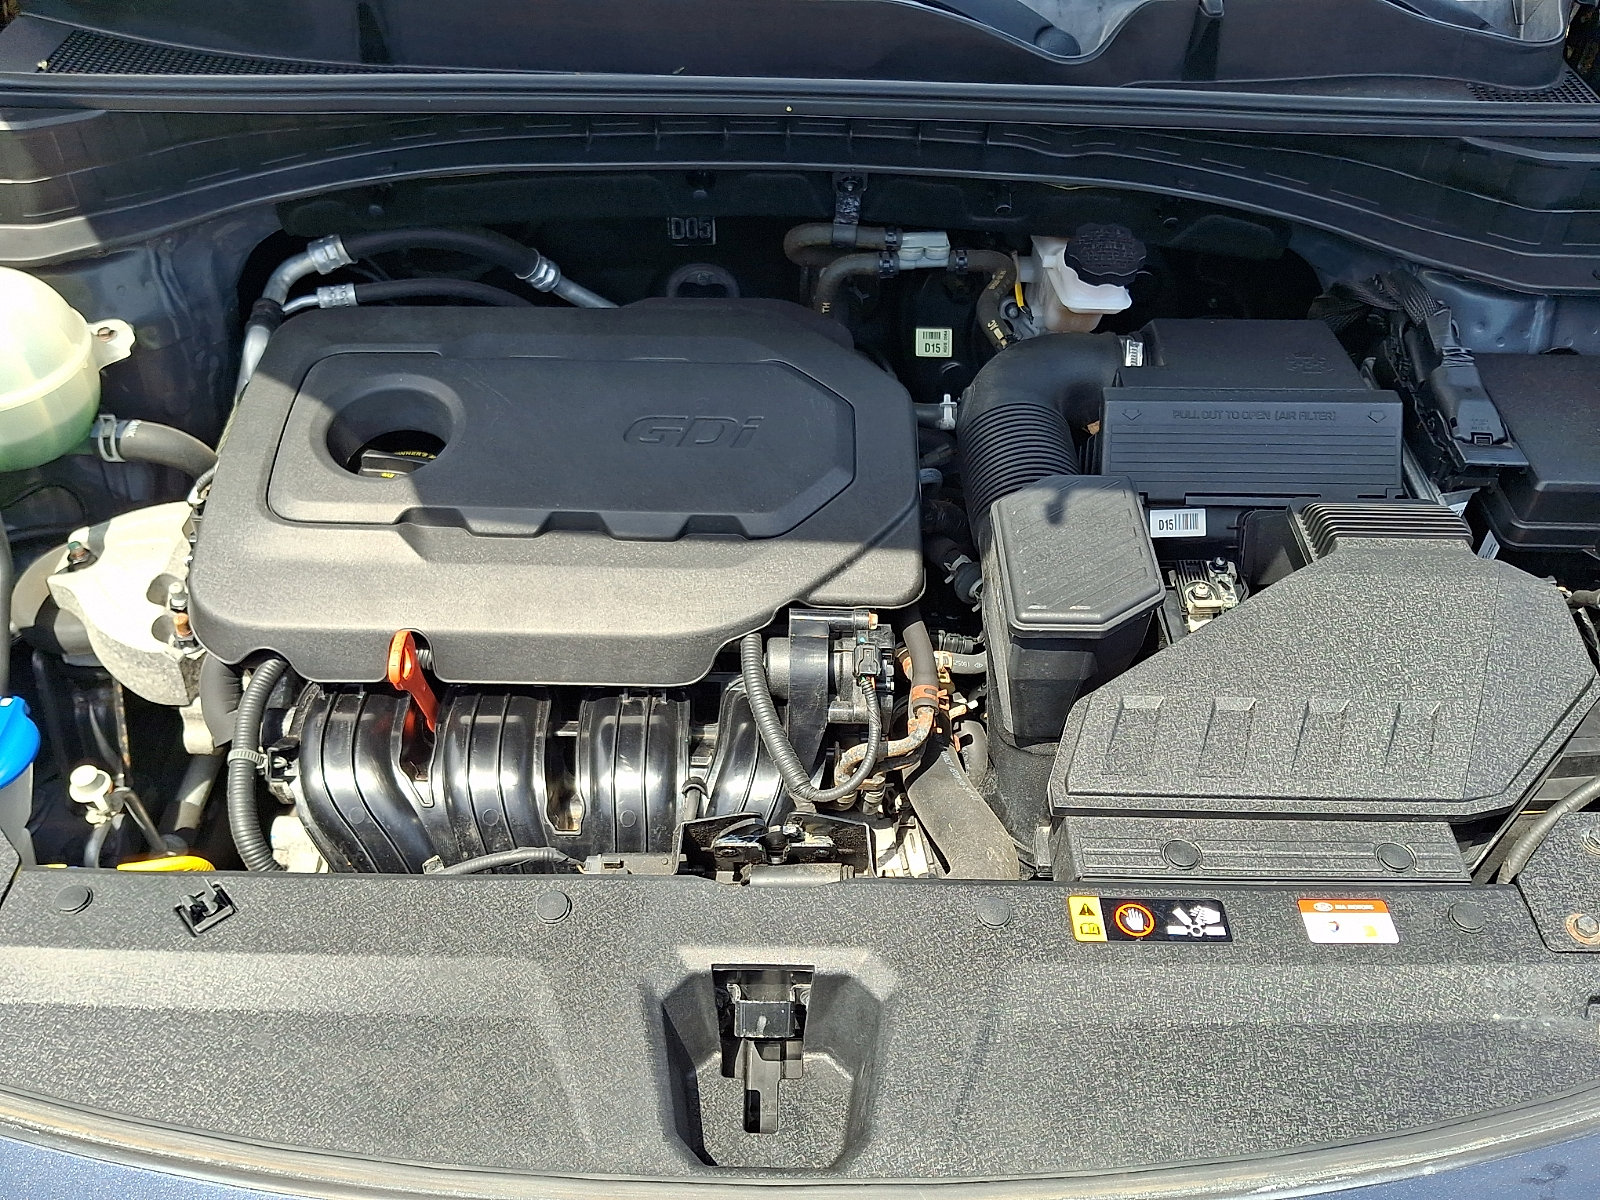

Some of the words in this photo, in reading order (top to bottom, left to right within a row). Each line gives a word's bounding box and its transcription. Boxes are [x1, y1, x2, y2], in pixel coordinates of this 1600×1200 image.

[924, 343, 941, 353] D15
[1173, 409, 1200, 419] PULL
[1202, 409, 1224, 420] OUT
[1225, 410, 1240, 420] TO
[1242, 410, 1271, 420] OPEN
[623, 415, 765, 448] GDi
[1158, 519, 1174, 531] D15
